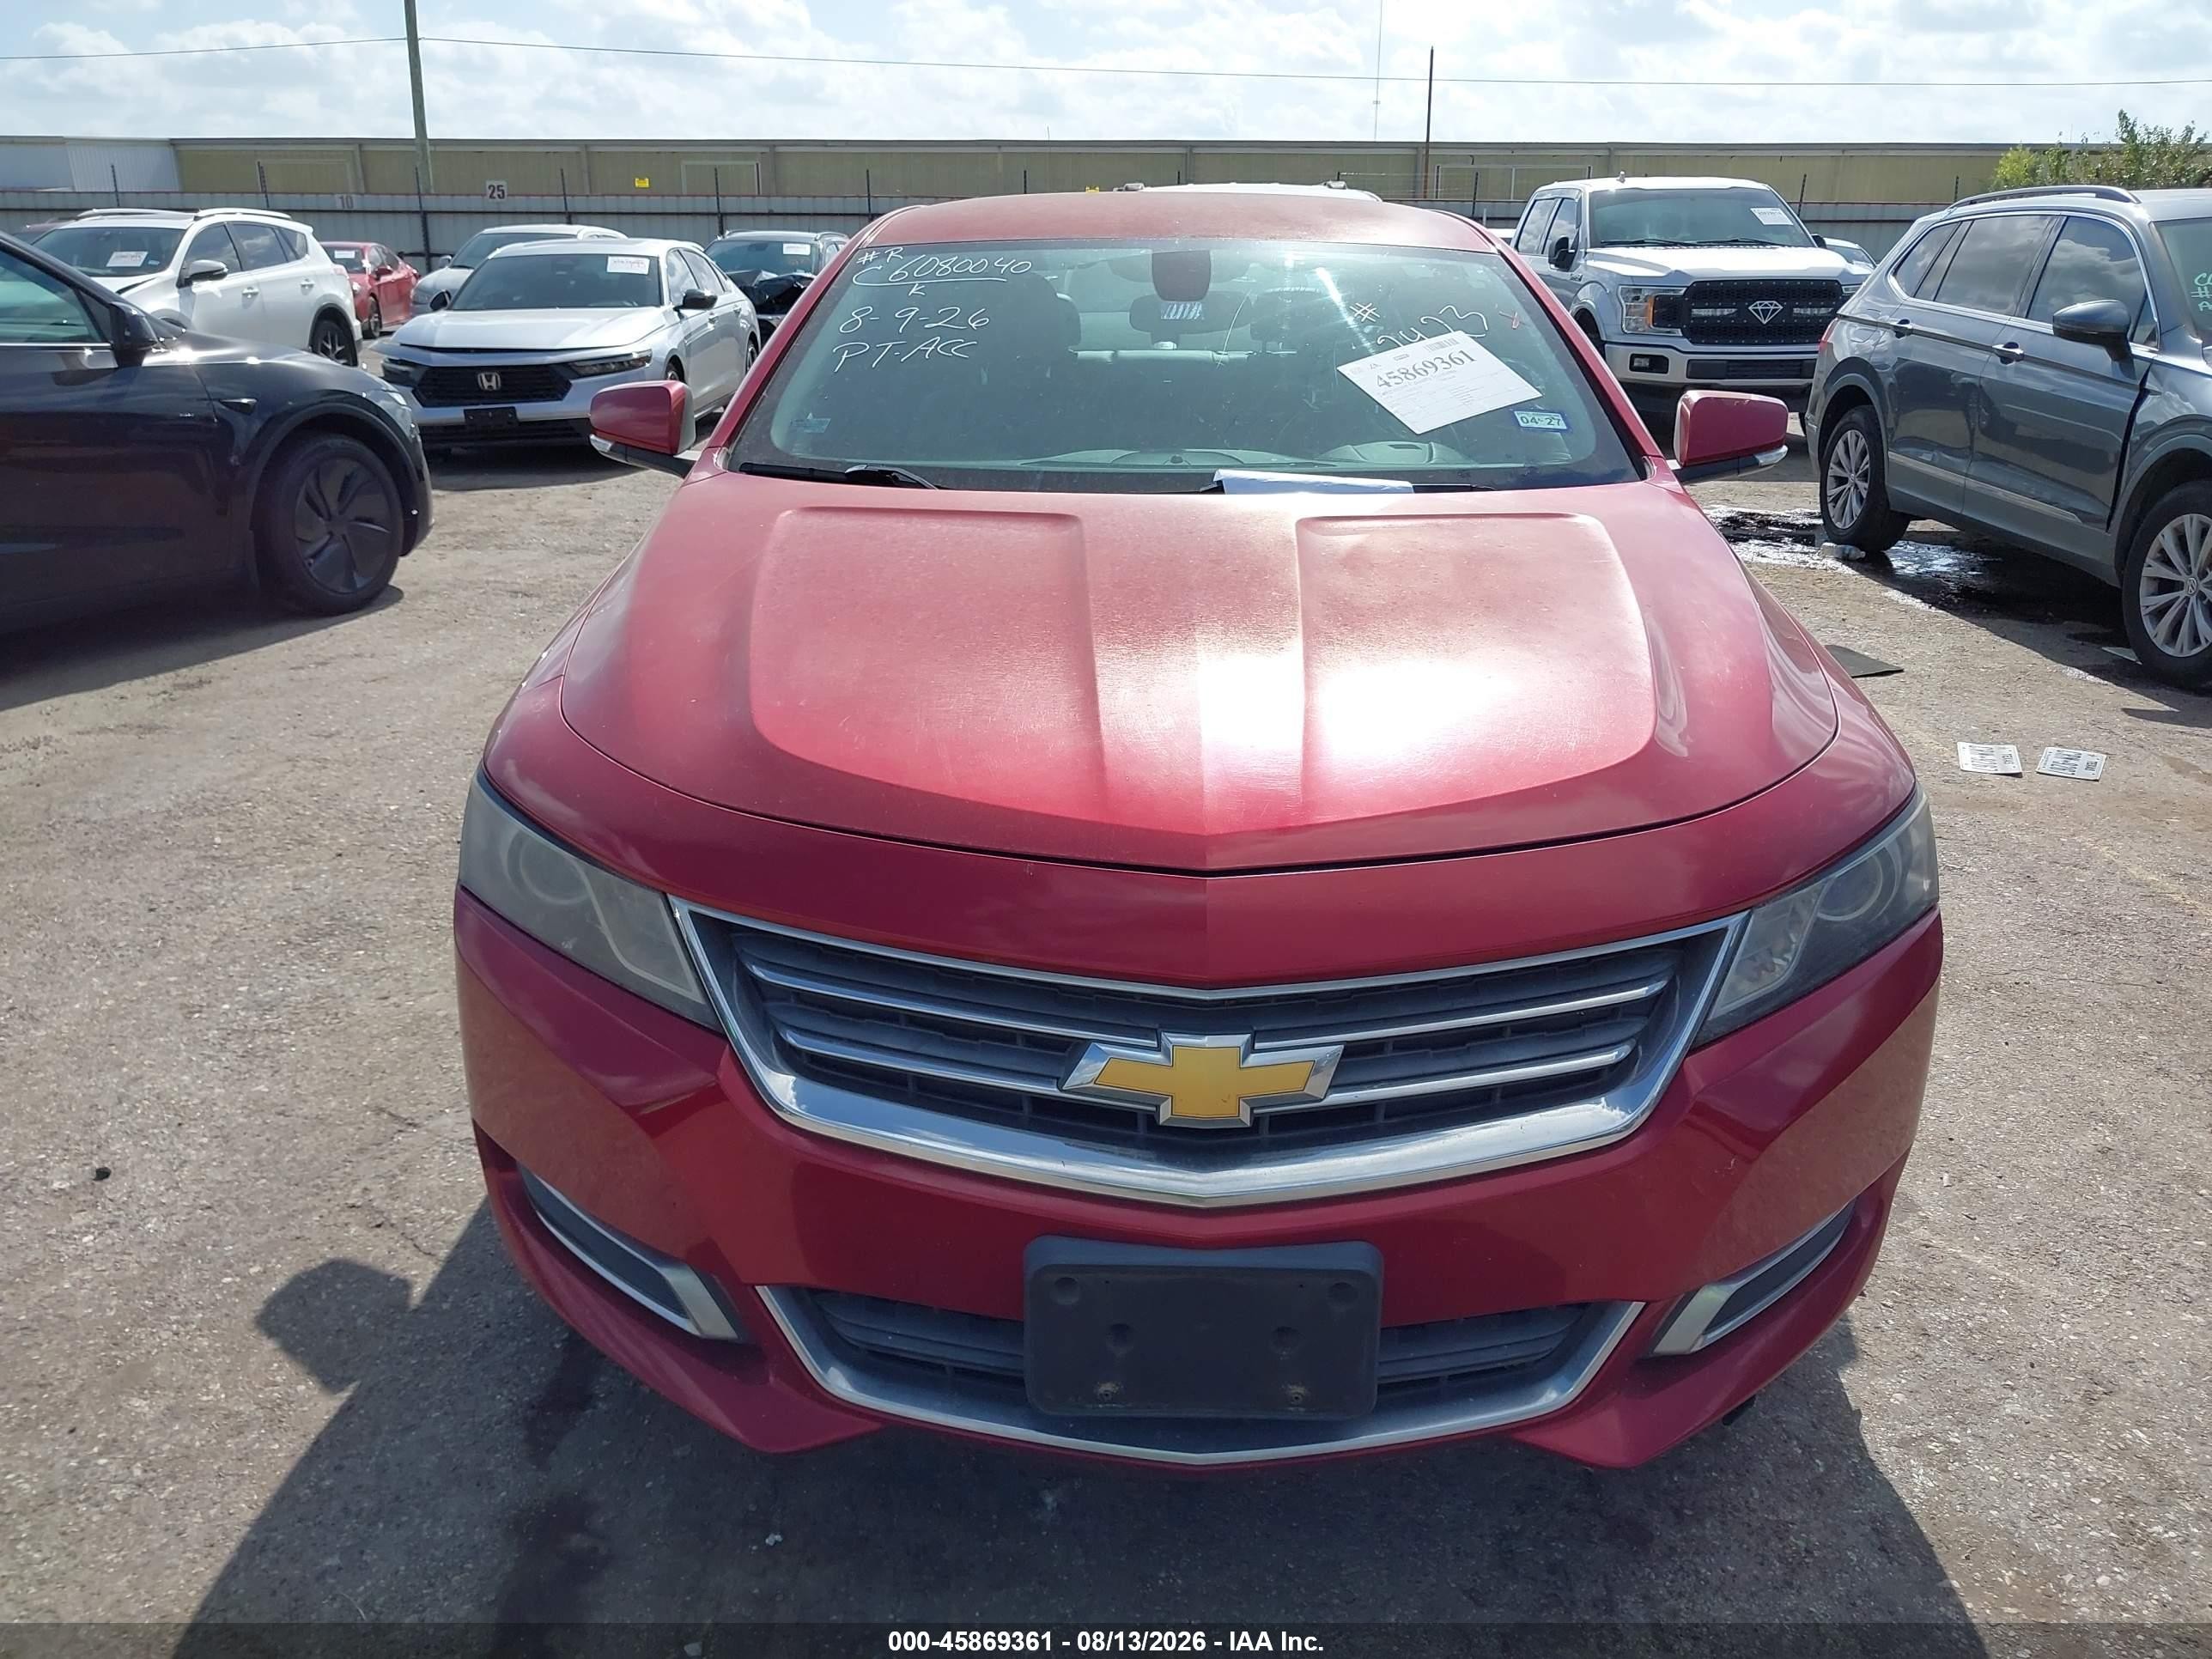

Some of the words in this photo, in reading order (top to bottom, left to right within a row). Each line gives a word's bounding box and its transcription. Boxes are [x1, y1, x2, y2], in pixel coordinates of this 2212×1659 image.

[488, 184, 506, 200] 25
[339, 195, 354, 210] 10
[1375, 349, 1478, 389] 45869361
